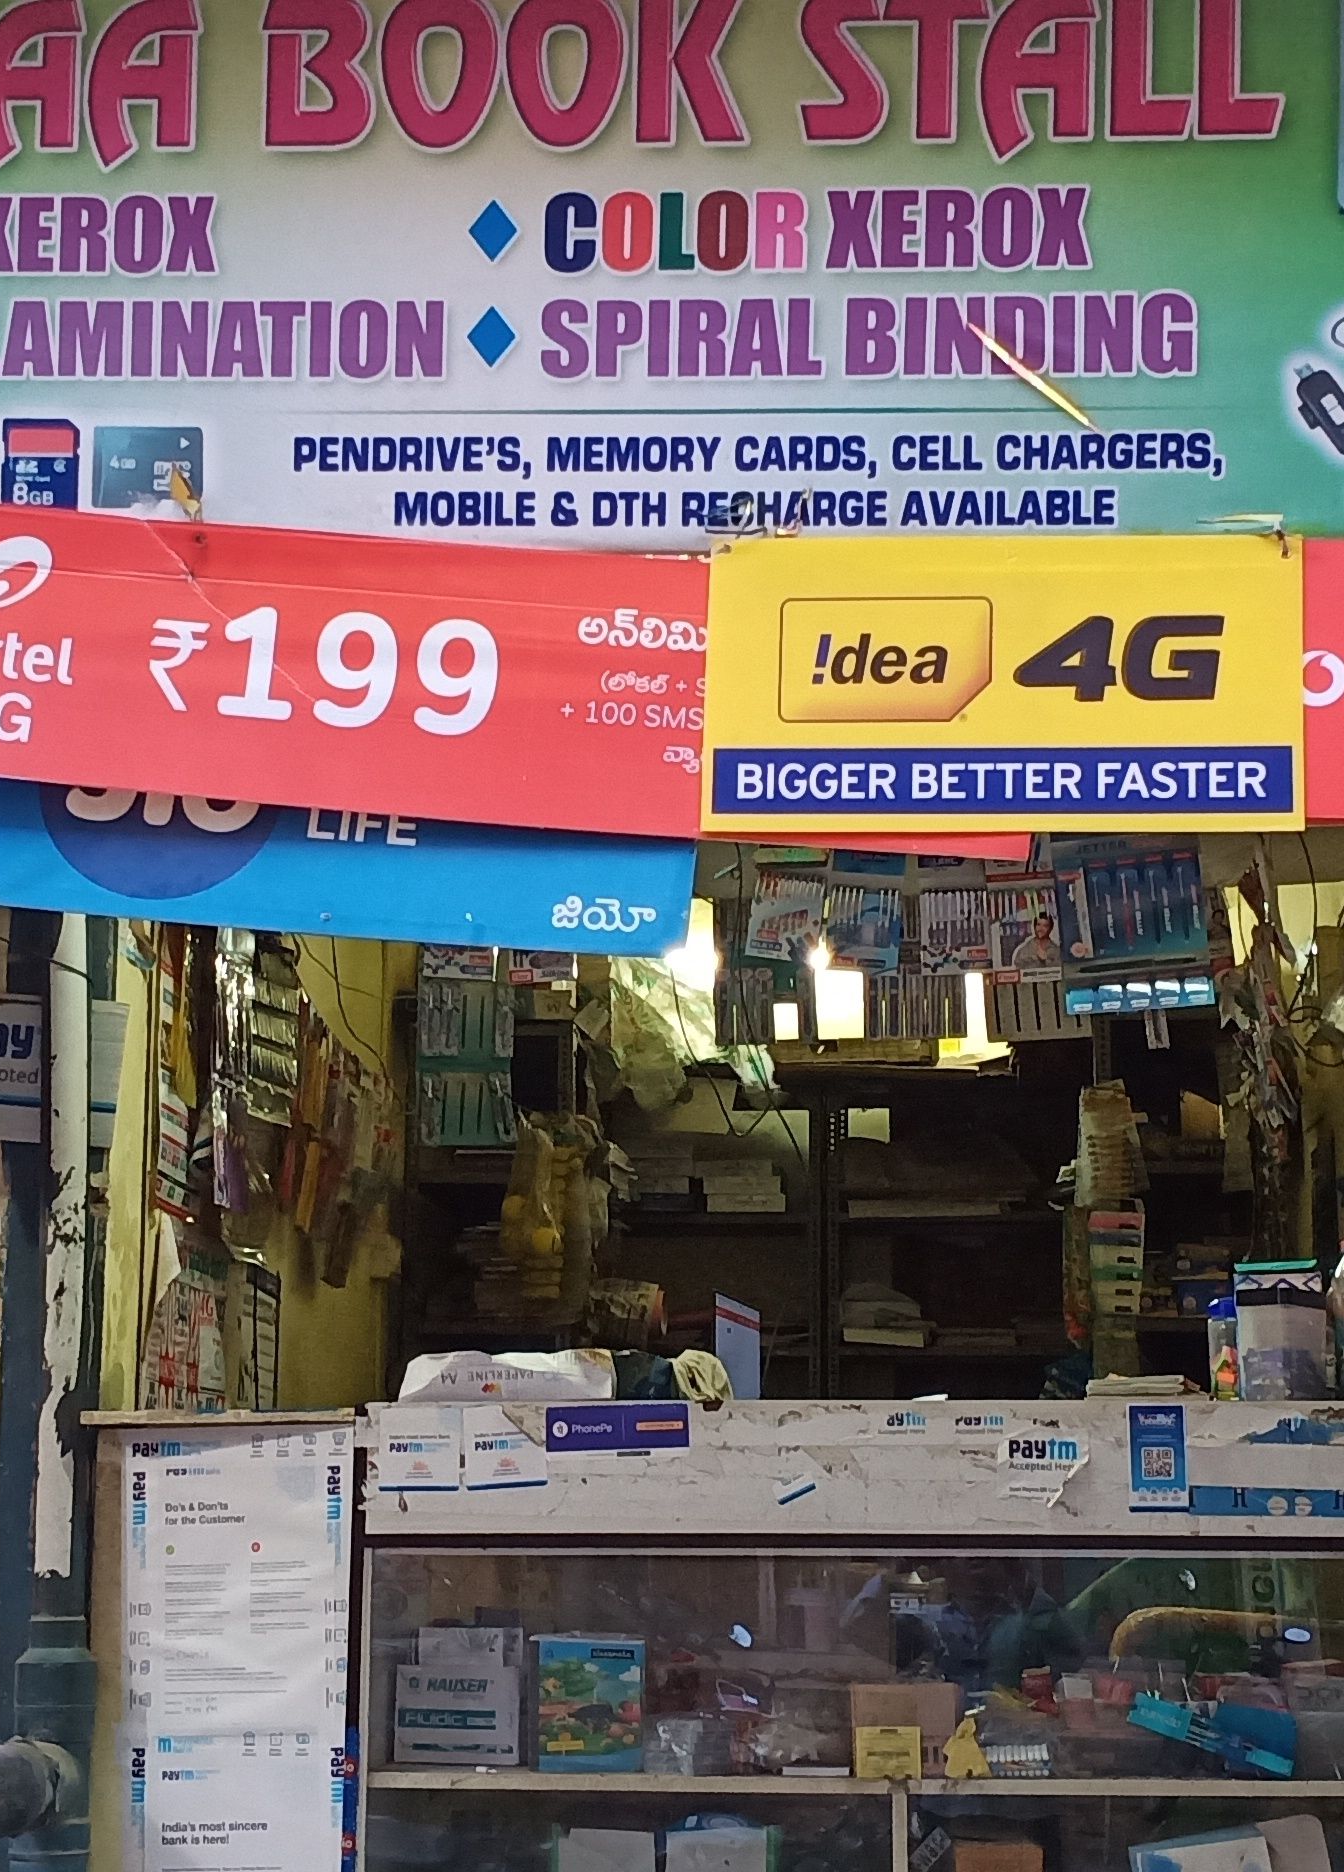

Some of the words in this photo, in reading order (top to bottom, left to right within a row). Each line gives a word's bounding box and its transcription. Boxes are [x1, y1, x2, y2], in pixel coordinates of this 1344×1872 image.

[263, 0, 750, 150] BOOK
[801, 0, 1285, 162] STALL
[543, 191, 808, 273] COLOR
[826, 186, 1091, 270] XEROX
[541, 297, 822, 379] SPIRAL
[845, 291, 1197, 378] BINDING
[293, 436, 531, 480] PENDRIVE'S,
[547, 437, 720, 472] MEMORY
[734, 436, 878, 479] CARDS,
[892, 434, 983, 471] CELL
[997, 432, 1224, 477] CHARGERS,
[13, 482, 54, 505] 8GB
[394, 492, 535, 526] MOBILE
[551, 492, 578, 526] &
[593, 491, 665, 526] DTH
[683, 490, 888, 526] RECHARGE
[900, 489, 1116, 526] AVAILABLE
[1013, 614, 1225, 701] 4G
[586, 701, 637, 725] 100
[644, 704, 703, 730] SMS
[735, 762, 896, 801] BIGGER
[910, 762, 1083, 800] BETTER
[1095, 761, 1267, 799] FASTER
[551, 896, 657, 934] జియో
[572, 1423, 613, 1434] PhonePe
[1009, 1461, 1052, 1472] Accepted
[165, 1516, 178, 1526] for
[181, 1515, 196, 1525] the
[199, 1514, 246, 1525] Customer
[161, 1822, 196, 1833] India's
[198, 1823, 226, 1832] most
[228, 1821, 268, 1832] sincere
[161, 1834, 188, 1846] bank
[191, 1834, 200, 1844] is
